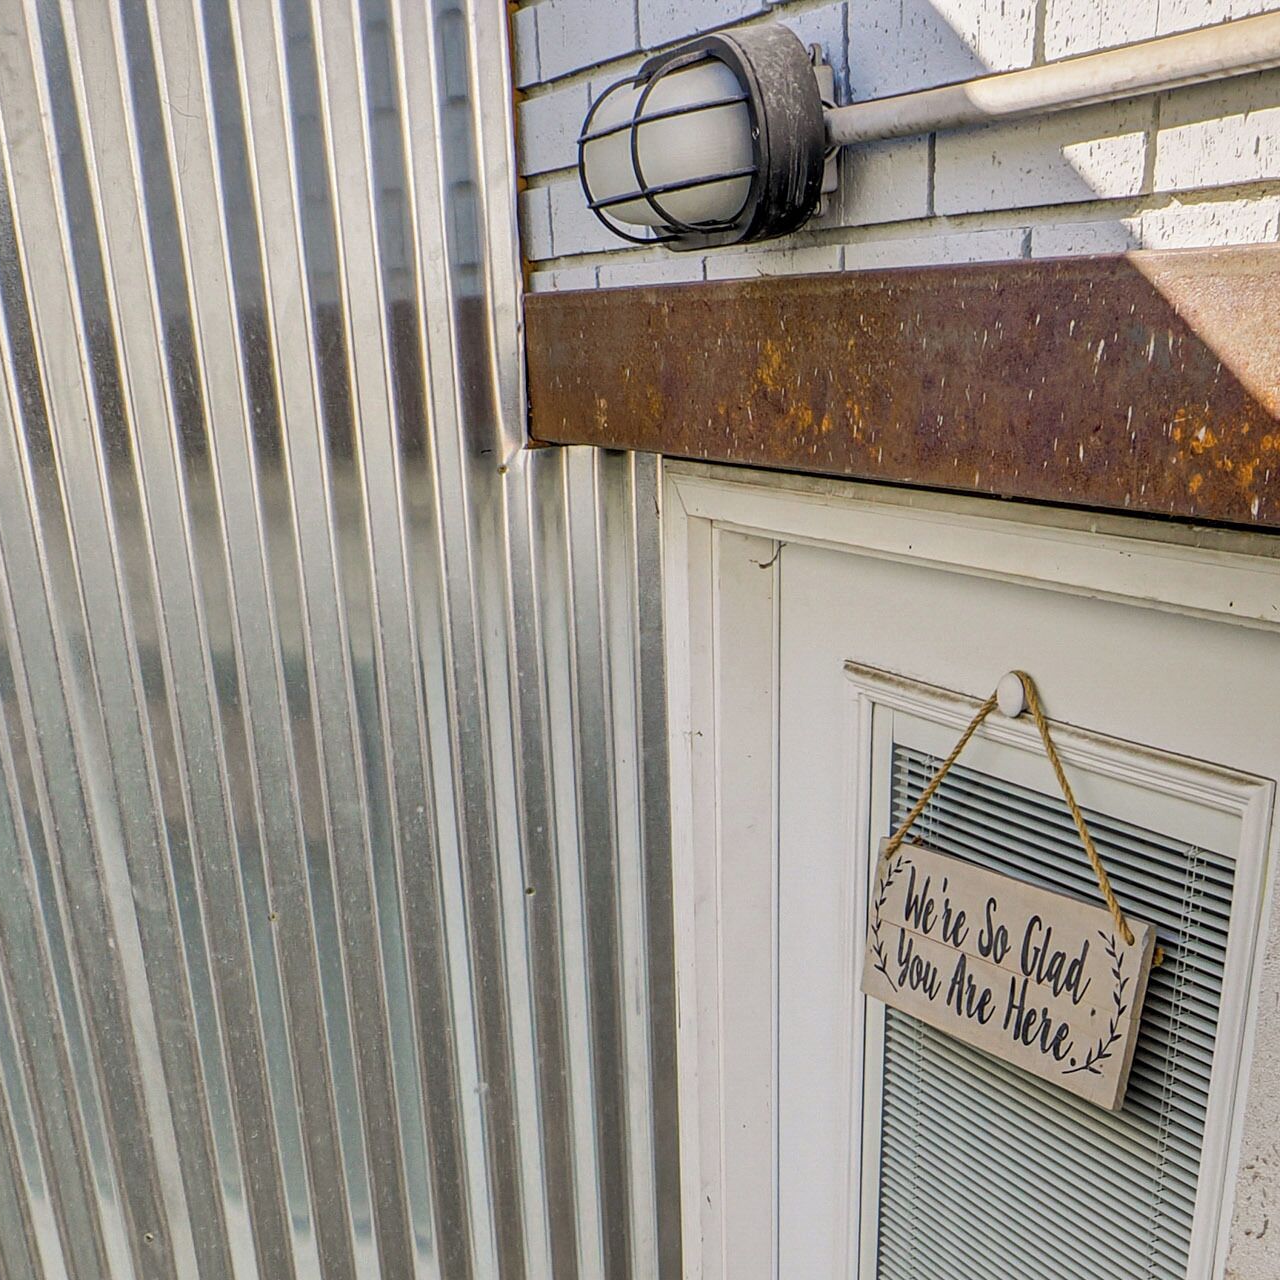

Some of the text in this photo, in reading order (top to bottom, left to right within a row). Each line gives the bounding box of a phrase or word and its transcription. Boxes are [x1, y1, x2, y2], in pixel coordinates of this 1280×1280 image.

[897, 928, 1077, 1067] You Are Here.
[904, 865, 1091, 1005] We're So Glad
